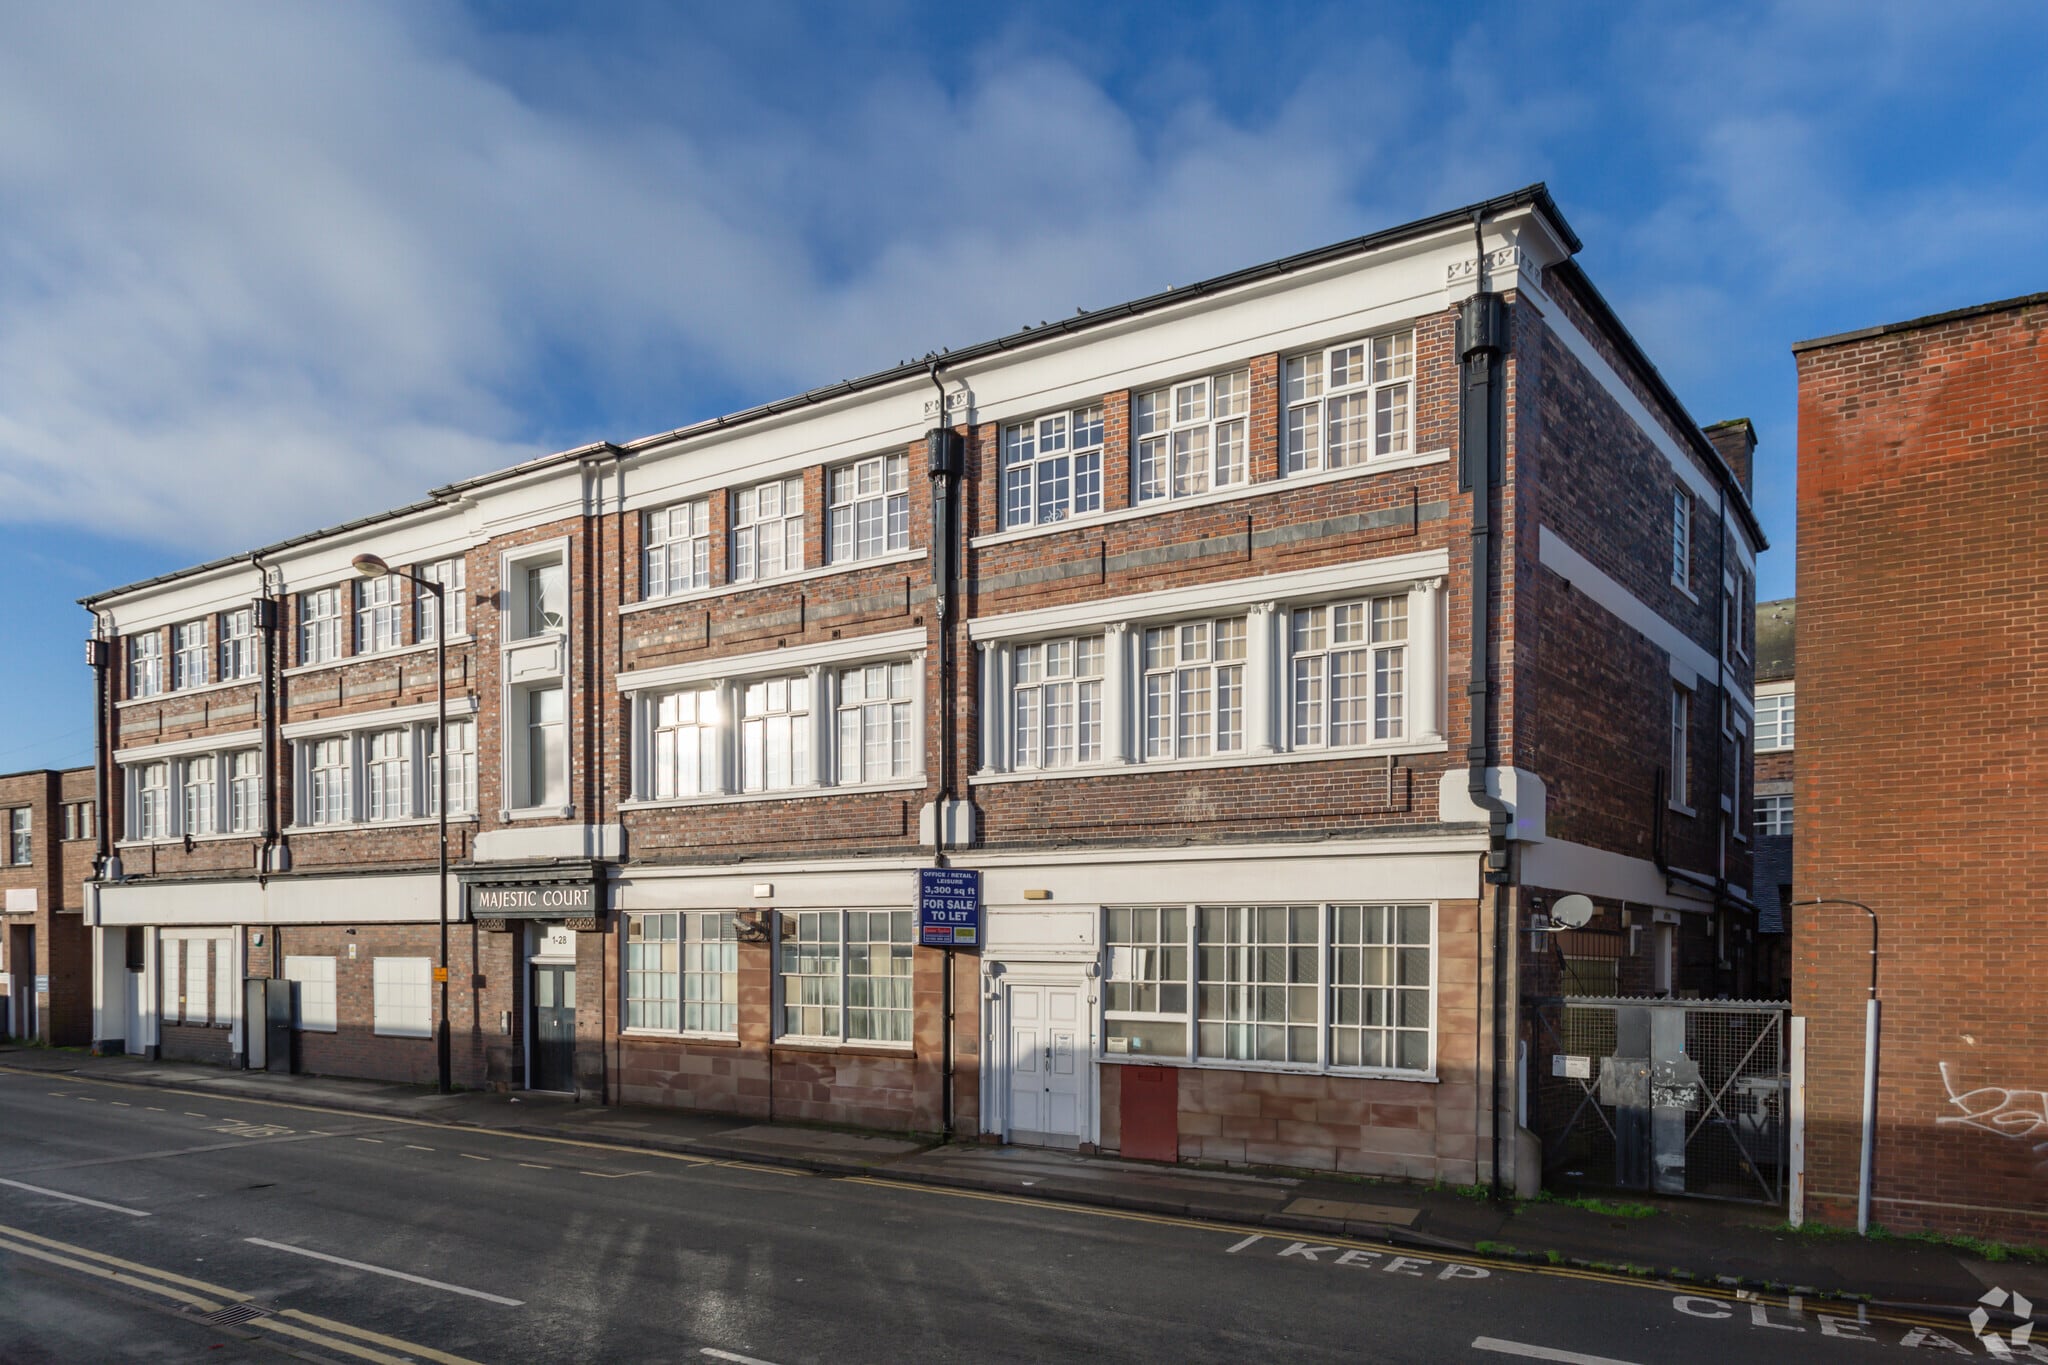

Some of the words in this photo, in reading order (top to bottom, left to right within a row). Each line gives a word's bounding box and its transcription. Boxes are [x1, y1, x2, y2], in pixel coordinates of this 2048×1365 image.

[925, 886, 951, 894] 3,300
[954, 888, 965, 896] sq
[968, 887, 976, 895] ft
[479, 890, 537, 908] MAJESTIC
[542, 889, 589, 906] COURT
[923, 899, 944, 909] FOR
[931, 910, 946, 921] TO
[949, 911, 968, 921] LET
[552, 935, 567, 945] 1-28
[1276, 1242, 1491, 1281] KEEP
